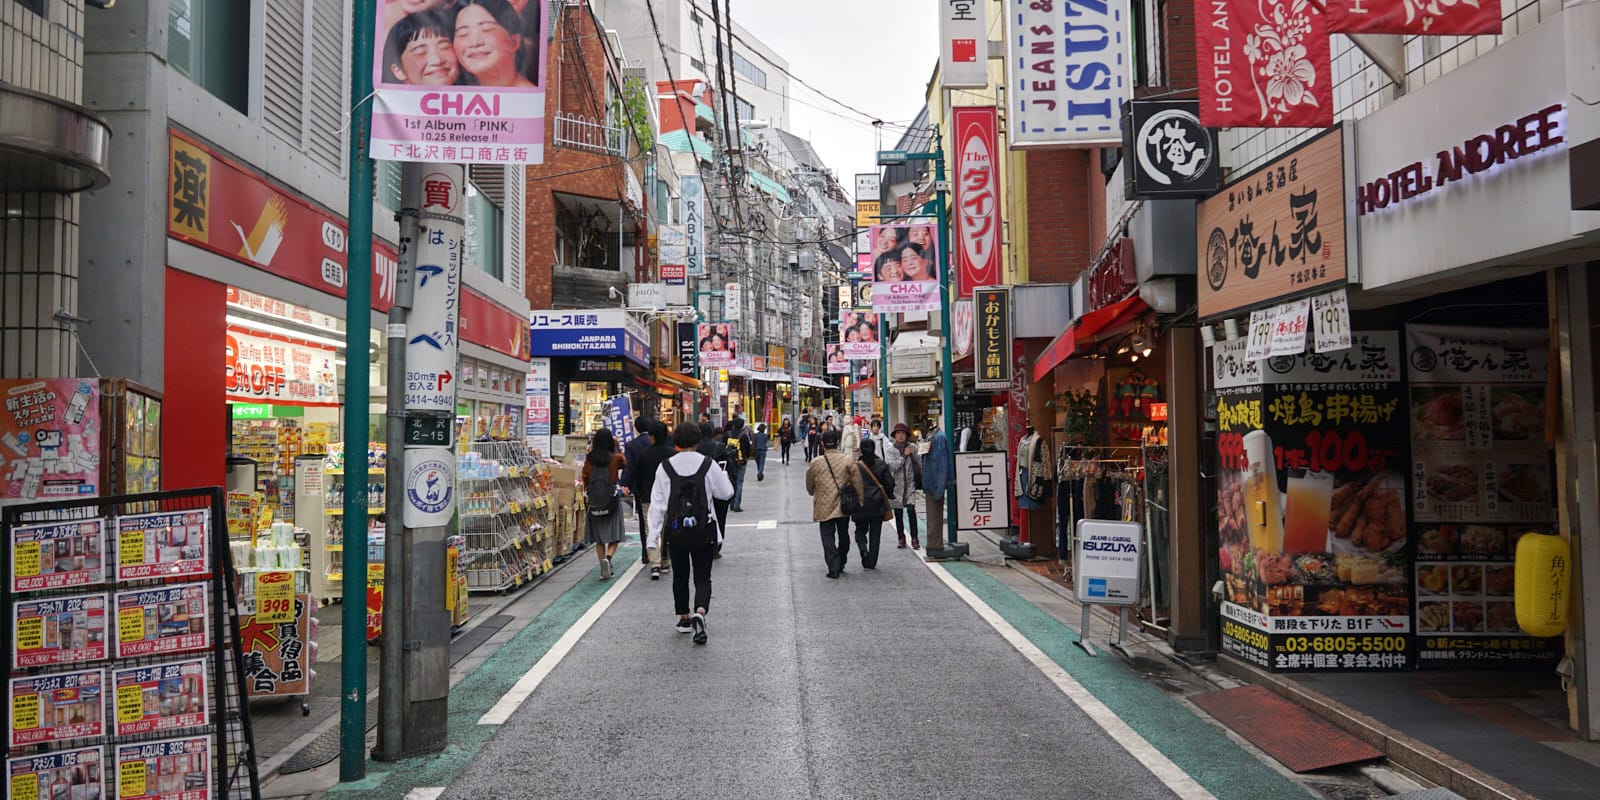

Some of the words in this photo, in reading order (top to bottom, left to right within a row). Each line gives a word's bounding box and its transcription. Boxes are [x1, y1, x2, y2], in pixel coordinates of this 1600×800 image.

[1030, 24, 1056, 111] JEANS
[1214, 37, 1233, 112] HOTEL
[420, 93, 500, 116] CHAI
[404, 119, 420, 129] 1st
[425, 119, 466, 131] Album
[420, 132, 447, 142] 10.25
[449, 133, 489, 142] Release
[389, 143, 528, 161] 下北沢南口商店街
[964, 152, 988, 162] The
[1358, 161, 1432, 216] HOTEL
[1436, 103, 1564, 187] ANDREE
[174, 150, 207, 233] 薬
[423, 180, 450, 209] 質
[858, 203, 880, 212] DUKE
[963, 167, 992, 255] ダイソー
[325, 226, 342, 248] くすり
[687, 200, 697, 269] RABIUS
[325, 262, 342, 283] 日用品
[890, 284, 923, 293] CHAI
[552, 343, 617, 351] SHIMOKITAZAWA
[985, 301, 1001, 379] おかもと歯科
[407, 372, 437, 382] 30m先
[408, 382, 435, 391] 右入る
[6, 391, 56, 411] 新生活の
[1268, 391, 1399, 426] 焼鳥・串揚げ
[14, 404, 55, 420] スタートに
[412, 430, 445, 441] 2-15
[968, 461, 994, 512] 古着
[973, 515, 992, 526] 2F
[1083, 541, 1137, 553] ISUZUYA
[1550, 555, 1565, 620] 角ハイボール
[67, 599, 82, 611] 202
[263, 598, 290, 614] 398
[1275, 618, 1342, 630] 階段を下りた
[1347, 618, 1373, 630] B1F
[1286, 636, 1406, 652] 03-6805-5500
[1275, 652, 1406, 668] 全席半個室・宴会受付中
[165, 666, 180, 678] 202
[65, 675, 78, 688] 201
[141, 745, 165, 759] AQUAS
[168, 741, 184, 754] 303
[32, 757, 55, 771] アネシス
[60, 752, 77, 766] 105
